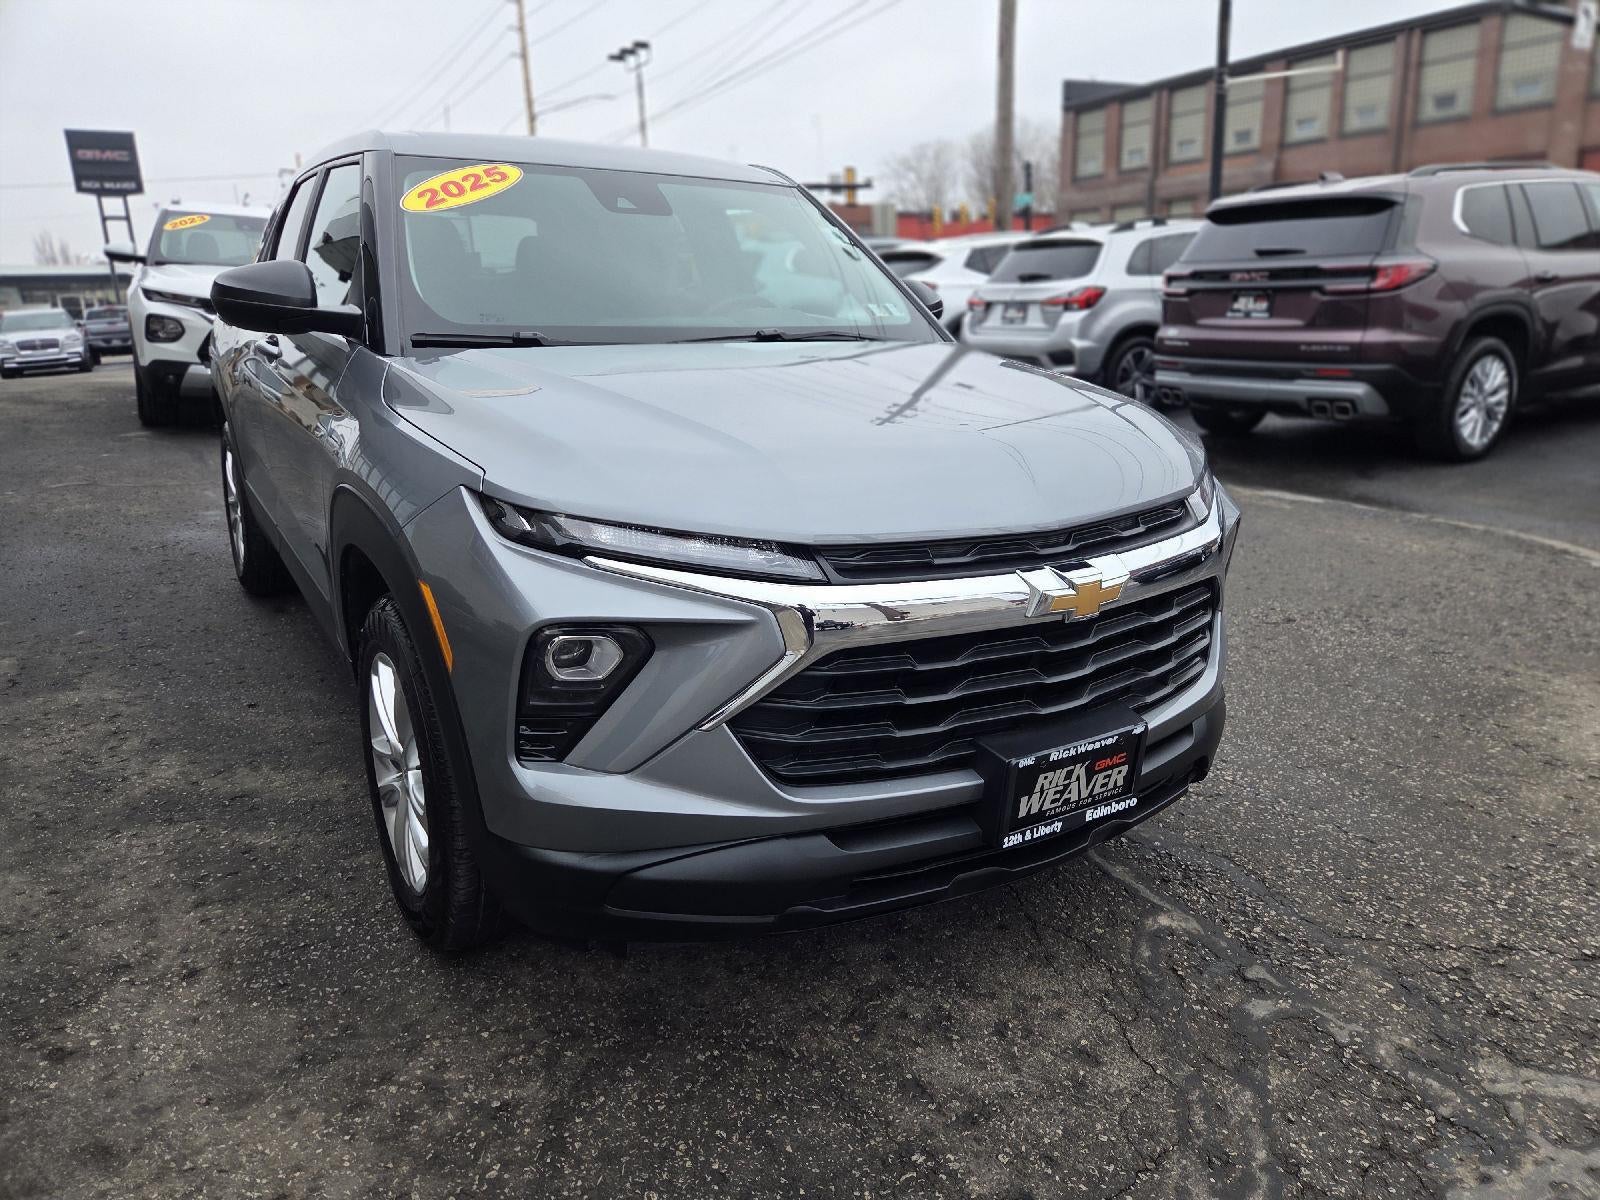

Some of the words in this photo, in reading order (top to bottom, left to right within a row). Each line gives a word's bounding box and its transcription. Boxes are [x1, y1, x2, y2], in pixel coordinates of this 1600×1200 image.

[76, 149, 130, 161] GMC
[417, 166, 509, 208] 2025
[170, 215, 207, 229] 2023
[1018, 757, 1036, 769] GMC
[1095, 752, 1127, 771] GMC
[1033, 760, 1092, 793] RICK
[1018, 765, 1128, 818] WEAVER
[1045, 802, 1077, 817] FAMOUS
[1078, 797, 1093, 806] FOR
[1094, 786, 1123, 801] SERVICE
[1085, 798, 1138, 821] Edinboro
[1002, 834, 1023, 849] 12th
[1024, 829, 1032, 841] &
[1032, 820, 1063, 837] Liberty
